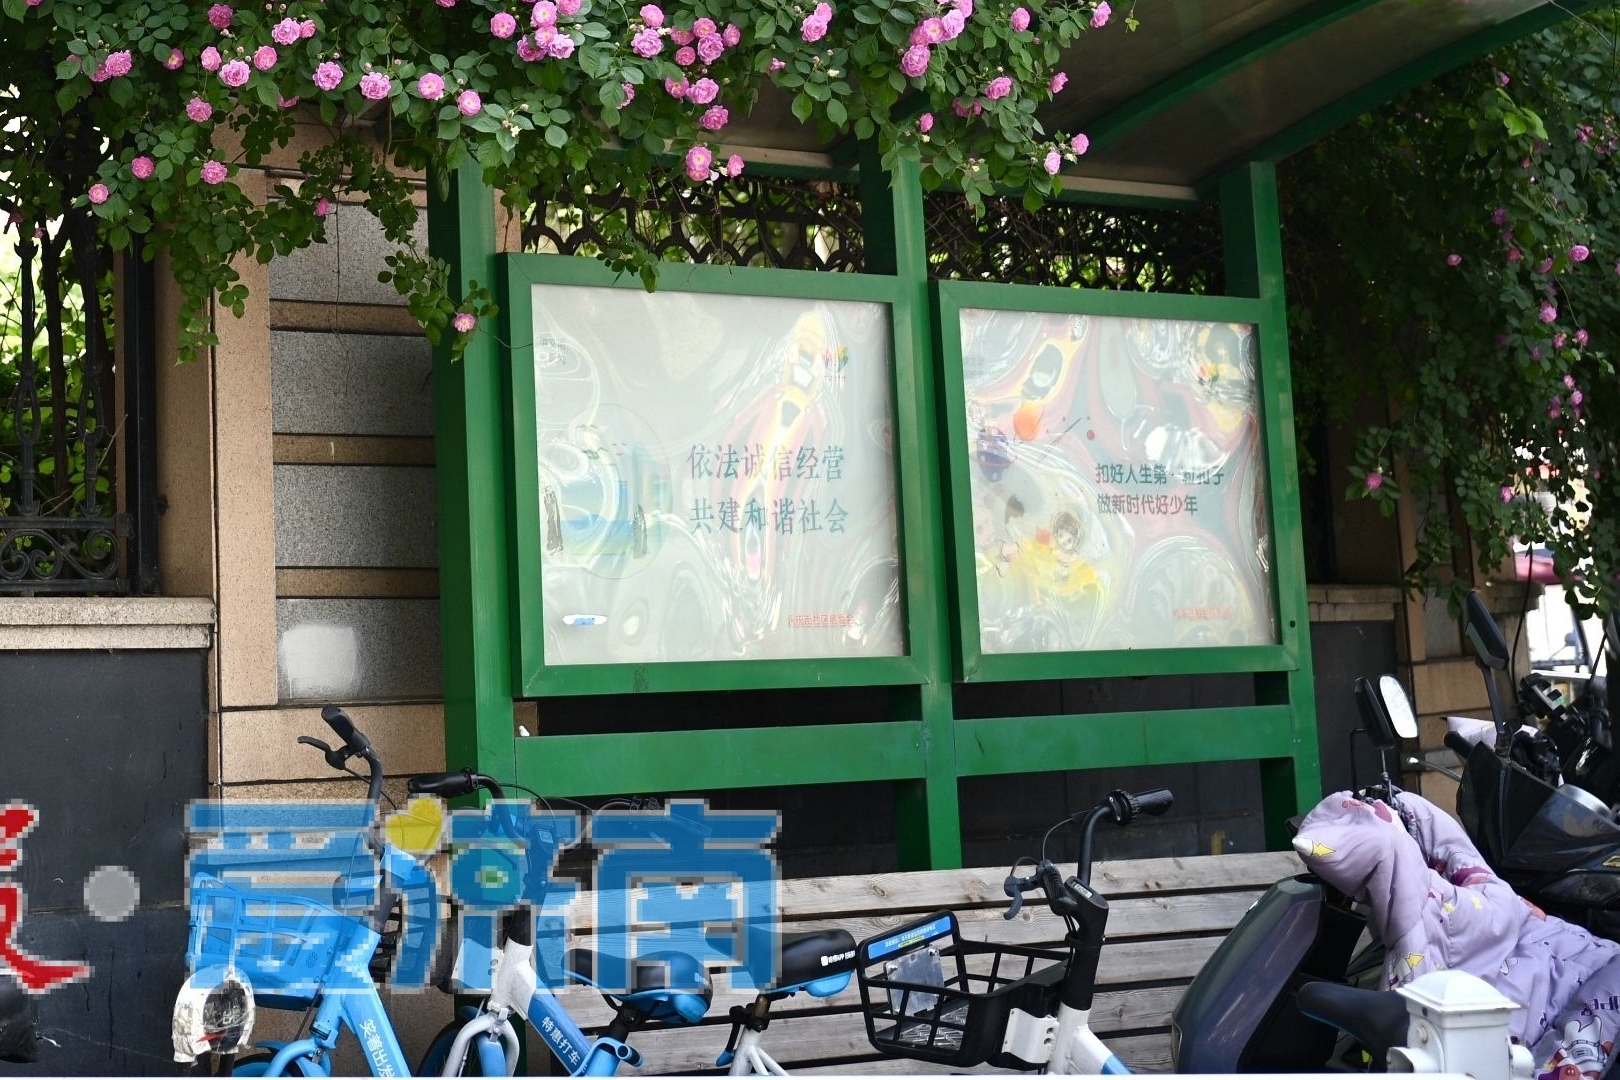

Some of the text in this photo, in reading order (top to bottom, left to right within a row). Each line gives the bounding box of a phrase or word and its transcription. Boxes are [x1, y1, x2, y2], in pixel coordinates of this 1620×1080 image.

[686, 443, 845, 482] 依法诚信经营
[690, 497, 849, 536] 共建和谐社会
[1097, 493, 1198, 516] 做新时代好少年
[541, 1016, 581, 1066] 特惠打车
